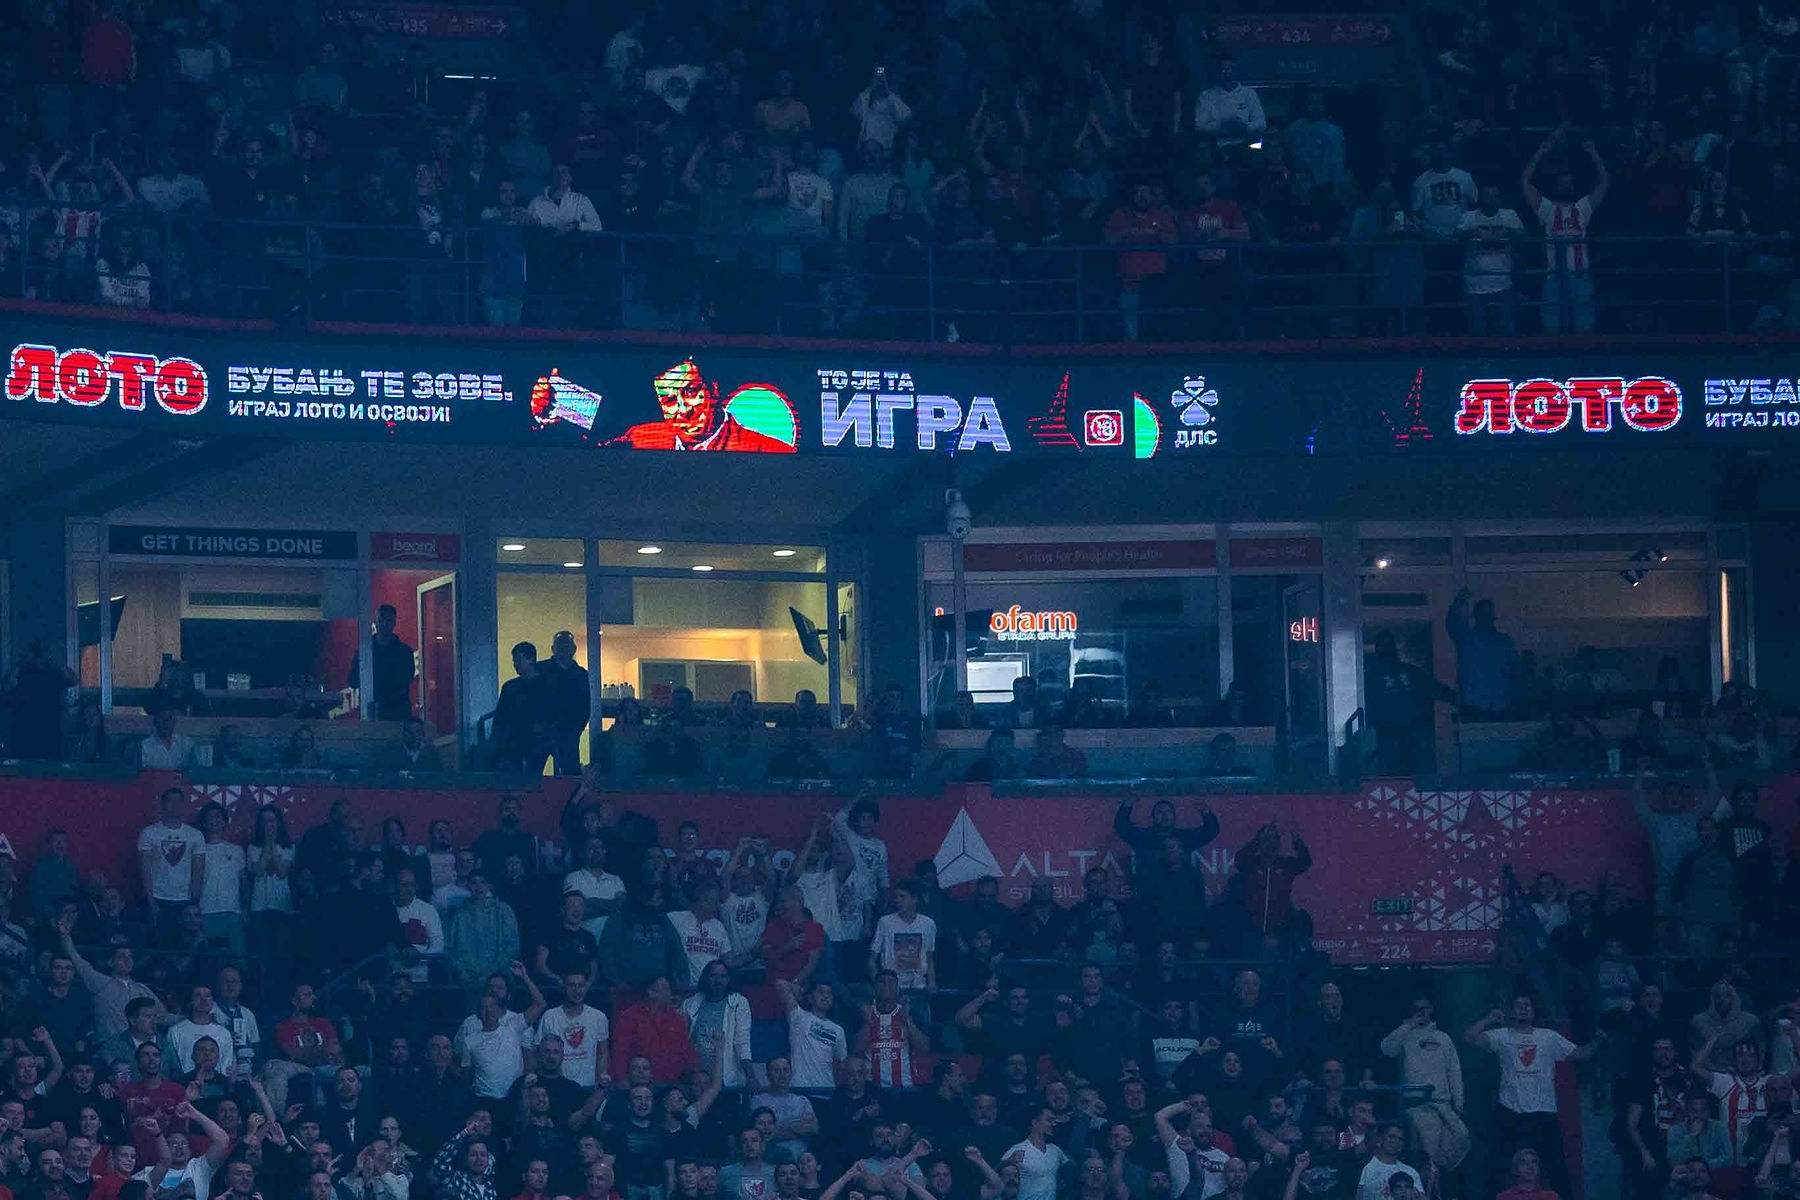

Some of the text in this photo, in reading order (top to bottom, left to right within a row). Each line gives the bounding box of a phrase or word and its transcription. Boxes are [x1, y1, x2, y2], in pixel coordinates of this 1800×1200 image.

[4, 343, 209, 415] ЛОТО
[228, 365, 513, 401] БУБАЊ ТЕ ЗОВЕ.
[817, 369, 848, 391] ТО
[884, 371, 915, 392] ТА
[1704, 378, 1800, 405] БУБА
[229, 399, 290, 419] ИГРАЈ
[293, 401, 346, 419] ЛОТО
[350, 402, 364, 419] И
[1454, 376, 1682, 434] ЛОТО
[821, 392, 1011, 451] ИГРА
[1705, 410, 1800, 427] ИГРАЈ ЛО
[1175, 429, 1218, 448] ДЛС
[142, 533, 324, 555] GET THINGS DONE
[990, 604, 1077, 632] ofarm
[1037, 631, 1077, 641] GRUPA
